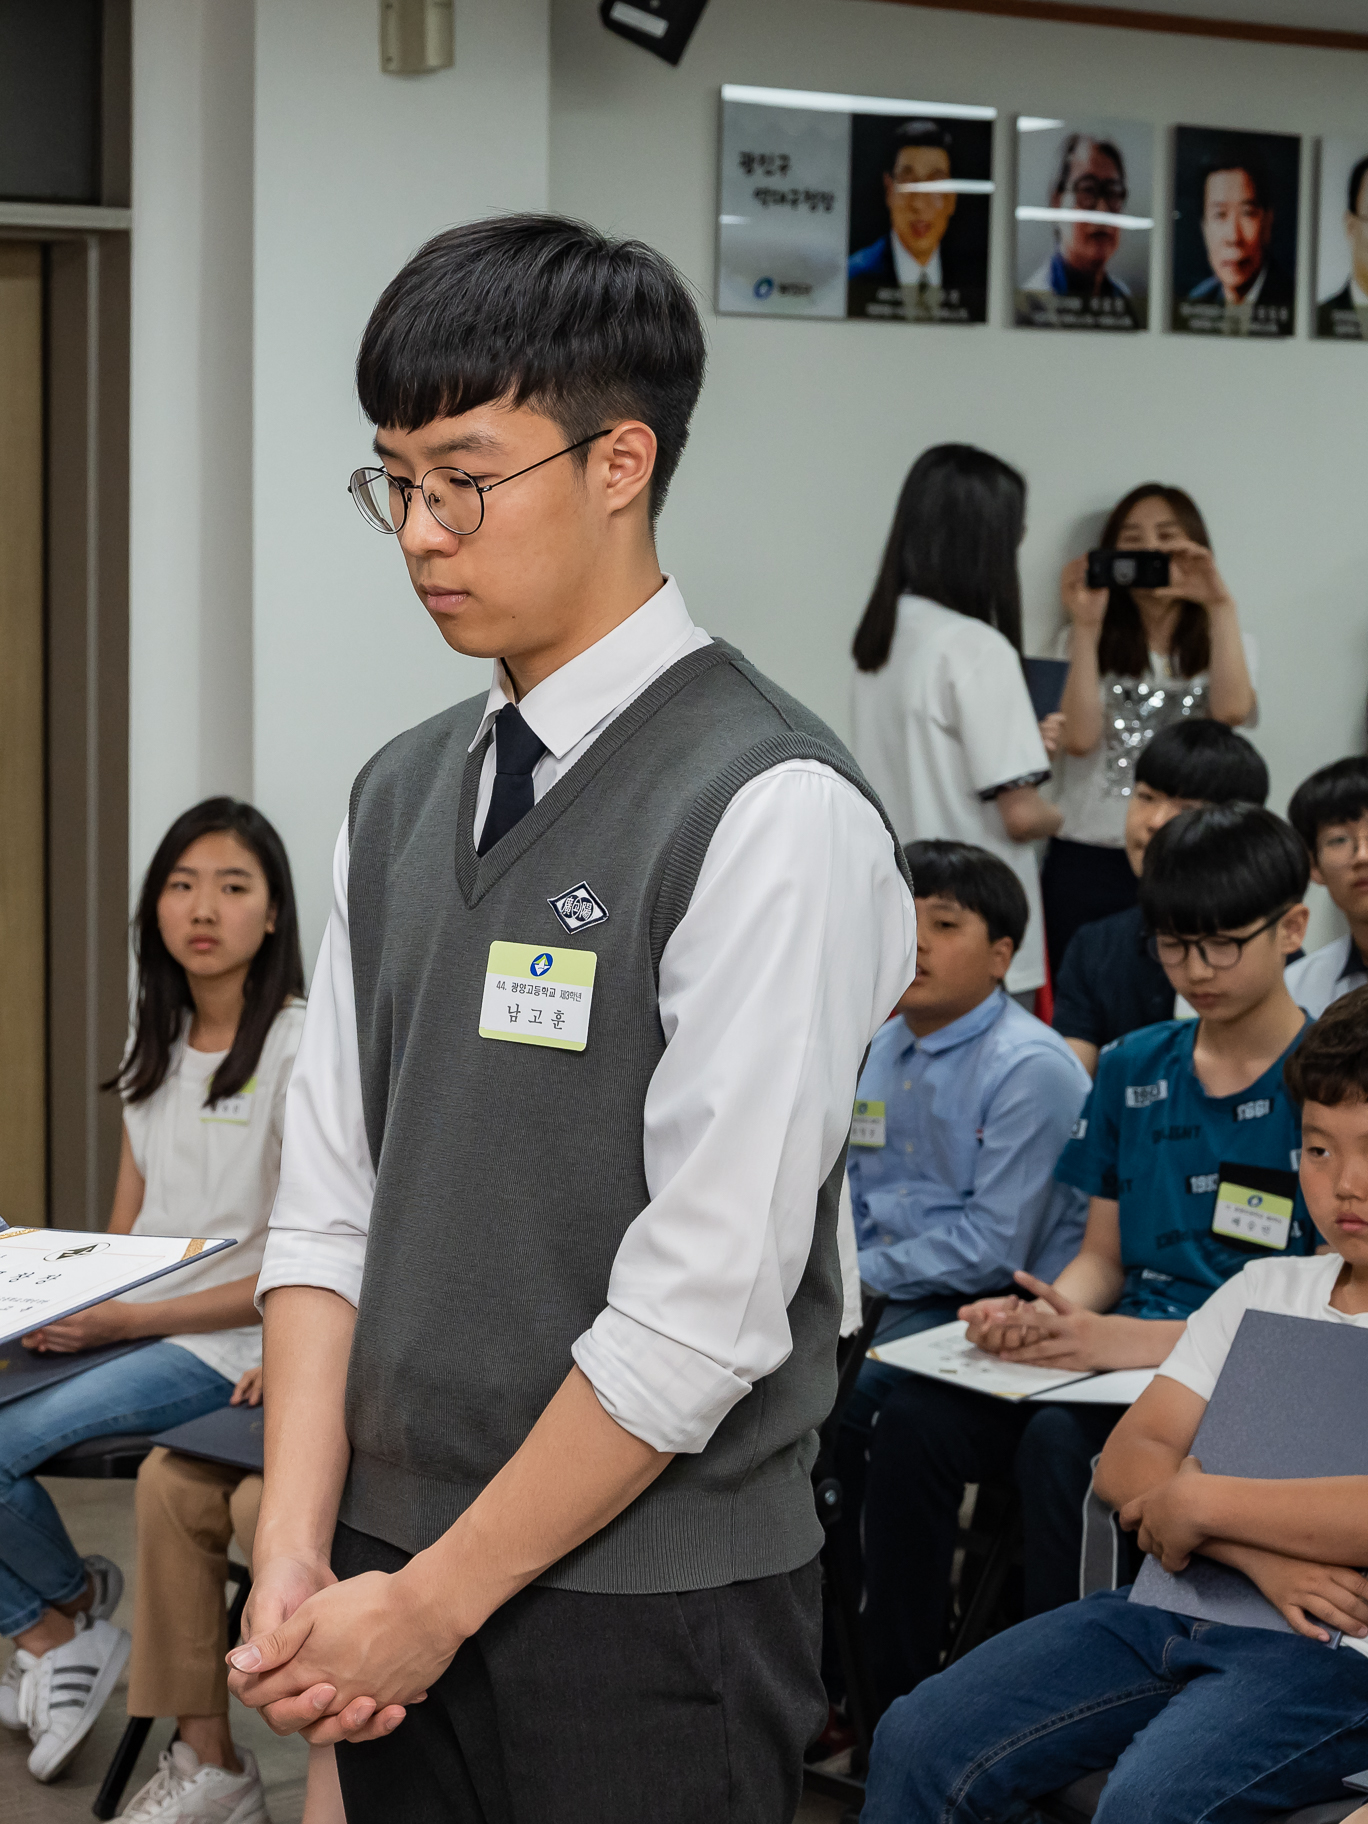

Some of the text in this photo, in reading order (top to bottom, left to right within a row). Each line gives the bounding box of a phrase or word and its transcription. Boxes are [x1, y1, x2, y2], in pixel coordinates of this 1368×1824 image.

[496, 980, 582, 1002] 44. 광양고등학교 제3학년
